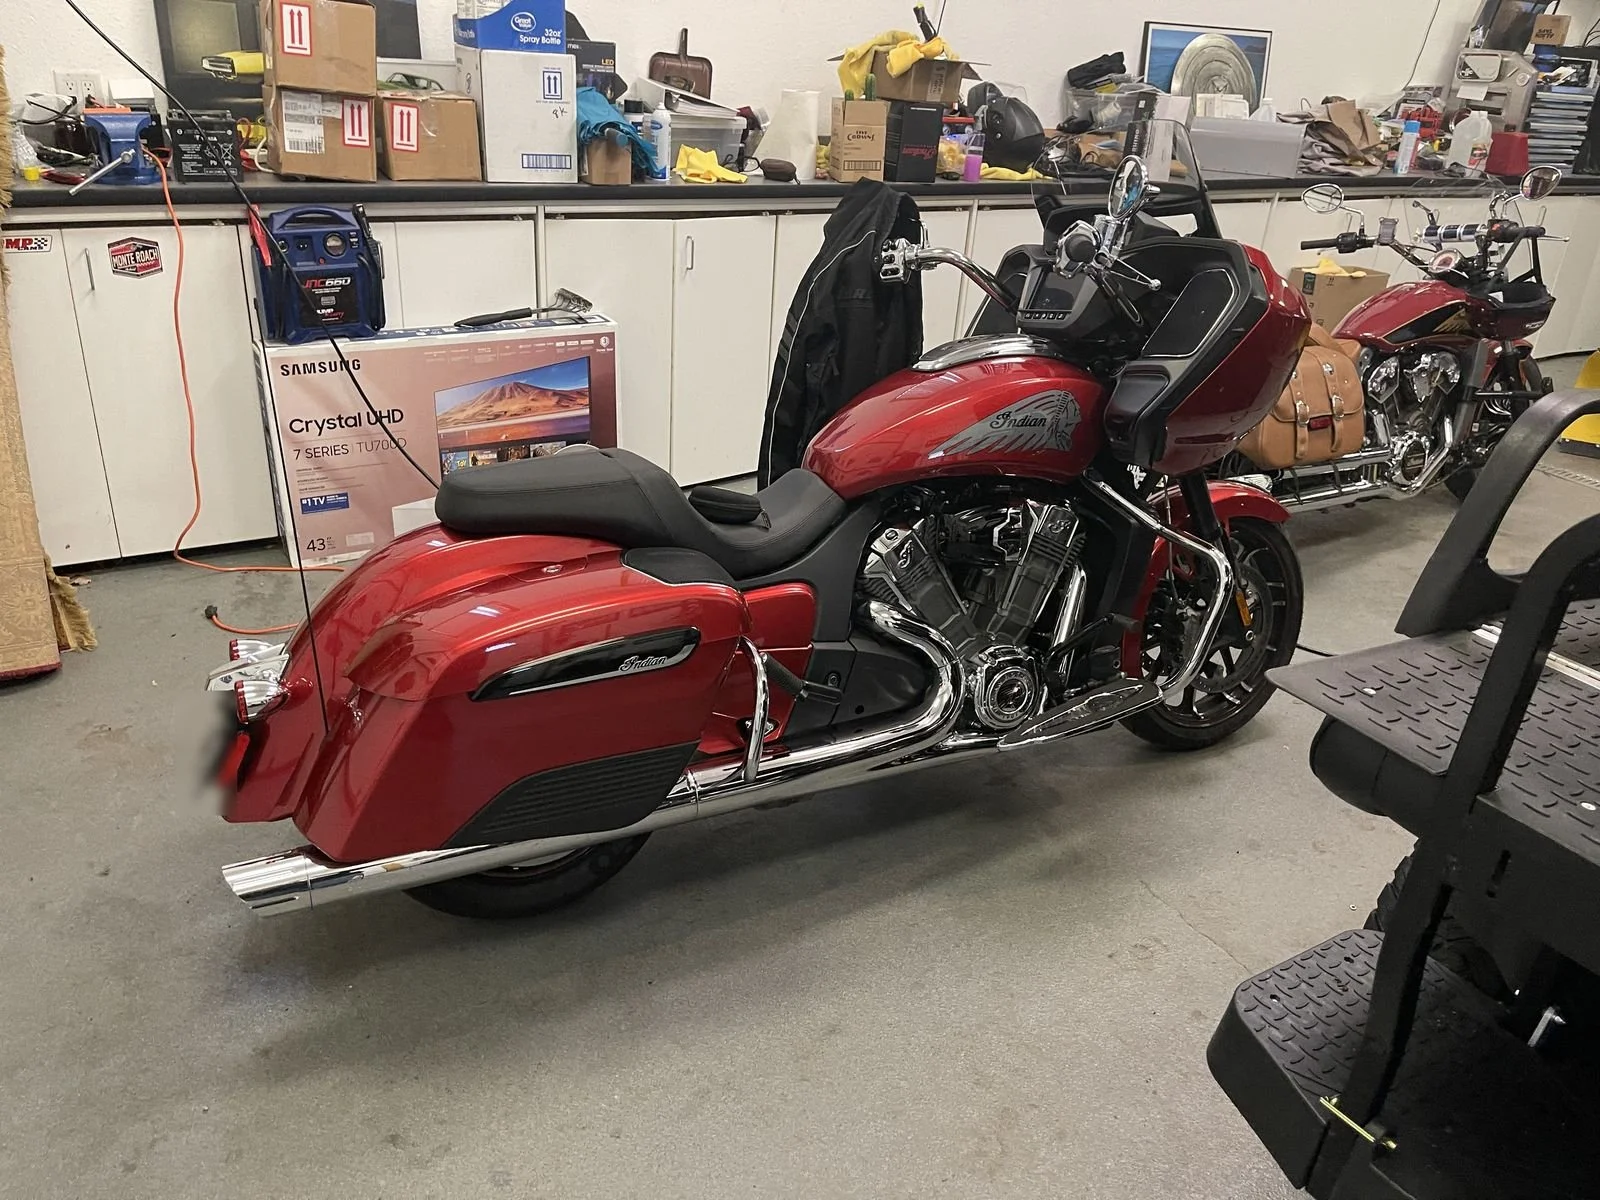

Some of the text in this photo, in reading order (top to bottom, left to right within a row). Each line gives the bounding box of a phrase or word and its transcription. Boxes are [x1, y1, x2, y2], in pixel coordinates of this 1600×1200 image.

[515, 16, 532, 24] Great
[519, 35, 561, 45] Spray Bottle
[1, 238, 34, 249] MP
[112, 248, 158, 268] MONTE ROACH
[280, 359, 361, 377] SAMSUNG
[289, 408, 404, 437] Crystal UHD
[989, 411, 1048, 429] Indian
[293, 449, 301, 460] 7
[305, 444, 349, 459] SERIES
[313, 496, 326, 506] TV
[618, 655, 668, 671] Indian
